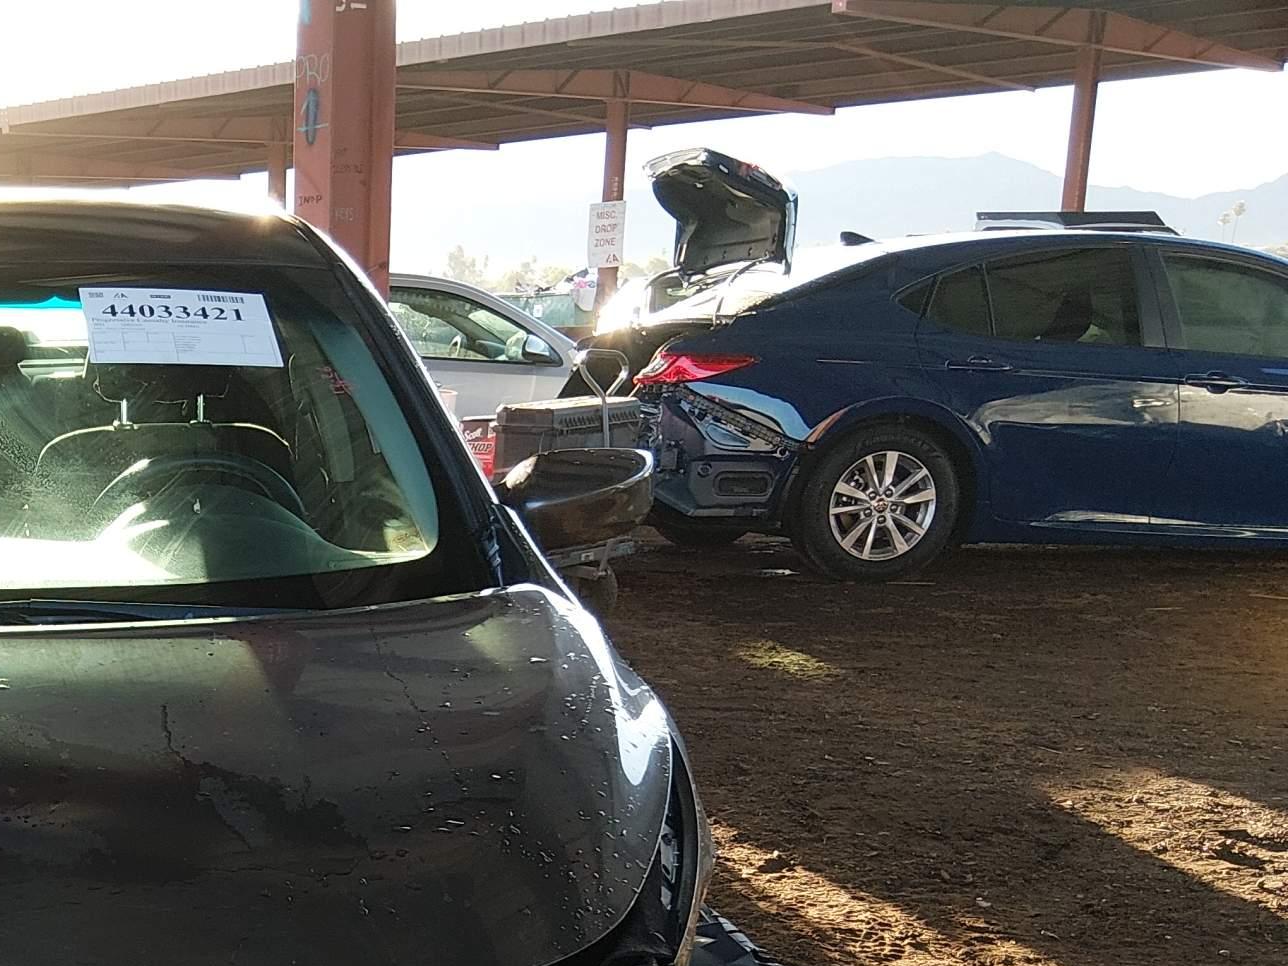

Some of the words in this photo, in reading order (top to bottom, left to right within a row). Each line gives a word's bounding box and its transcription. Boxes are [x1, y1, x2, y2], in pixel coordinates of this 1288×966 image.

[595, 223, 618, 234] DROP
[594, 237, 617, 248] ZONE
[102, 304, 245, 321] 44033421
